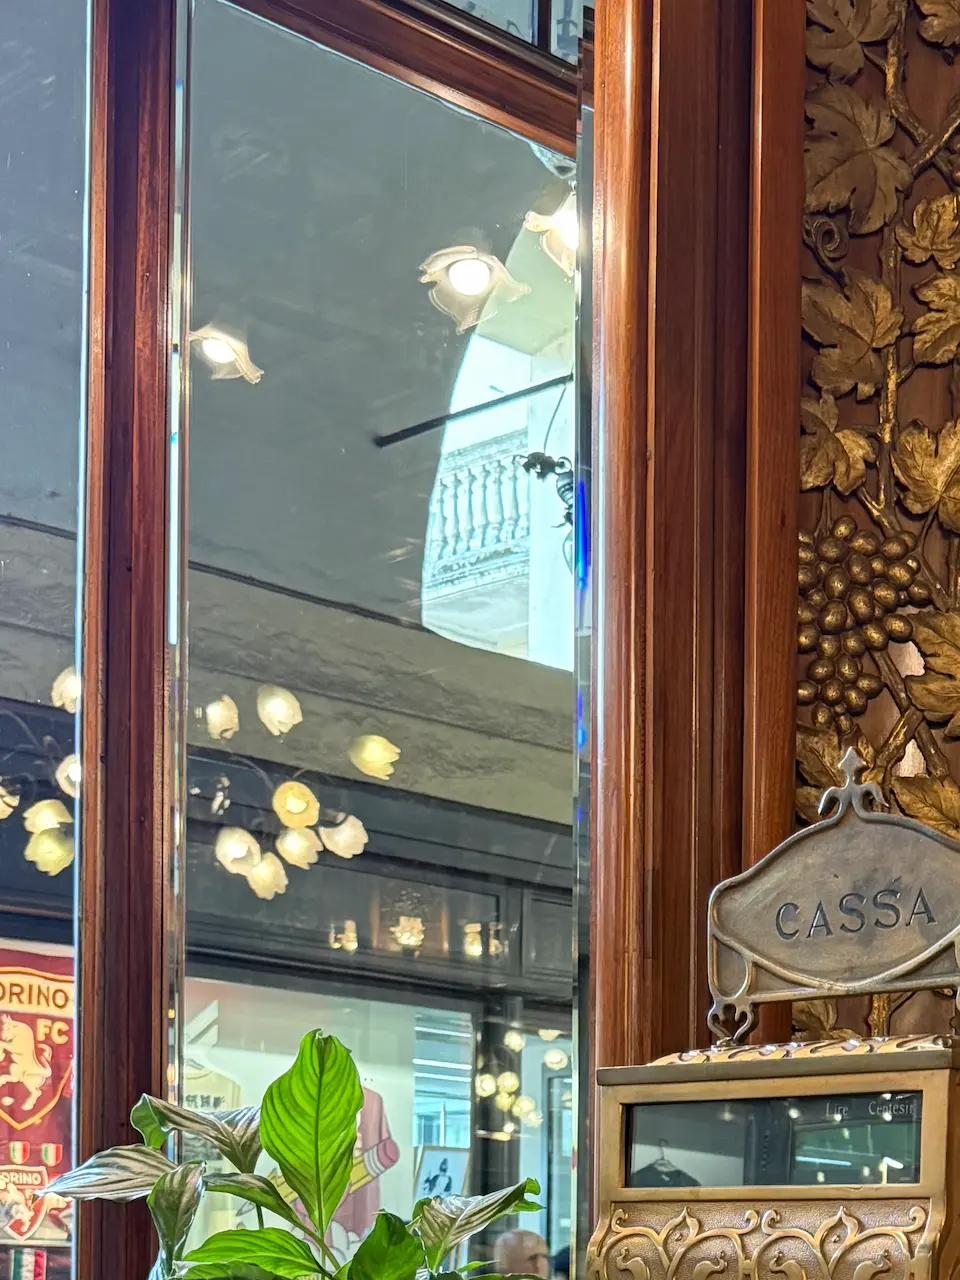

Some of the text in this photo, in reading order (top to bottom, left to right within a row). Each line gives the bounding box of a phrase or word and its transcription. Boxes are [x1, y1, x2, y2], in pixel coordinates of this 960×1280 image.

[775, 888, 938, 940] CASSA
[37, 1018, 70, 1045] FC
[826, 1102, 848, 1117] Lire
